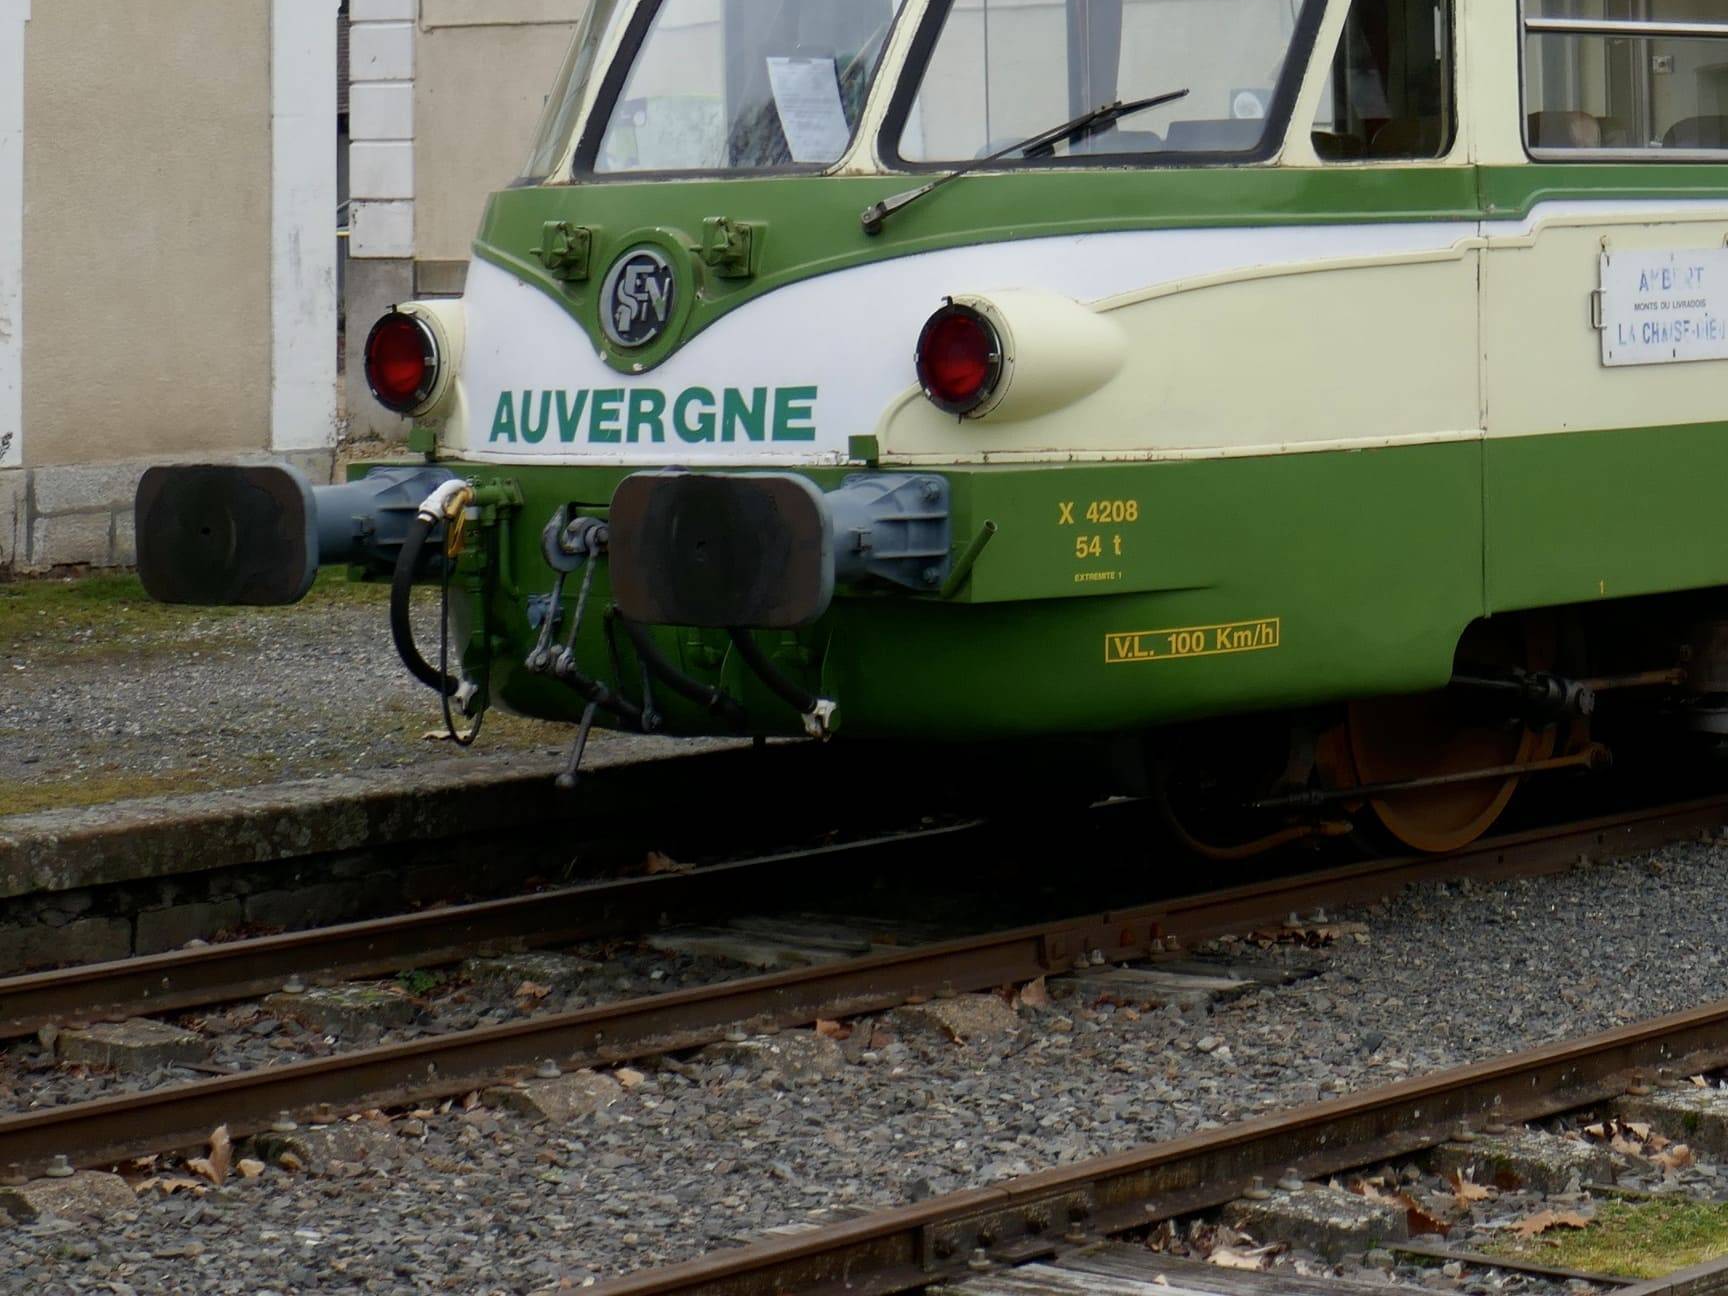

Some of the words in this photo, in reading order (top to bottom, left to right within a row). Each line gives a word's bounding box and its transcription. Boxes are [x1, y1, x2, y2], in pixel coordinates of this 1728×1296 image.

[1633, 301, 1658, 312] MONTS
[1660, 300, 1670, 310] DU
[1672, 298, 1707, 310] LIVRADOIS
[488, 385, 819, 445] AUVERGNE
[1058, 502, 1075, 525] X
[1086, 500, 1138, 523] 4208
[1075, 535, 1102, 558] 54
[1114, 535, 1122, 555] t
[1114, 637, 1154, 658] V.L.
[1168, 631, 1205, 654] 100
[1216, 623, 1274, 650] Km/h
